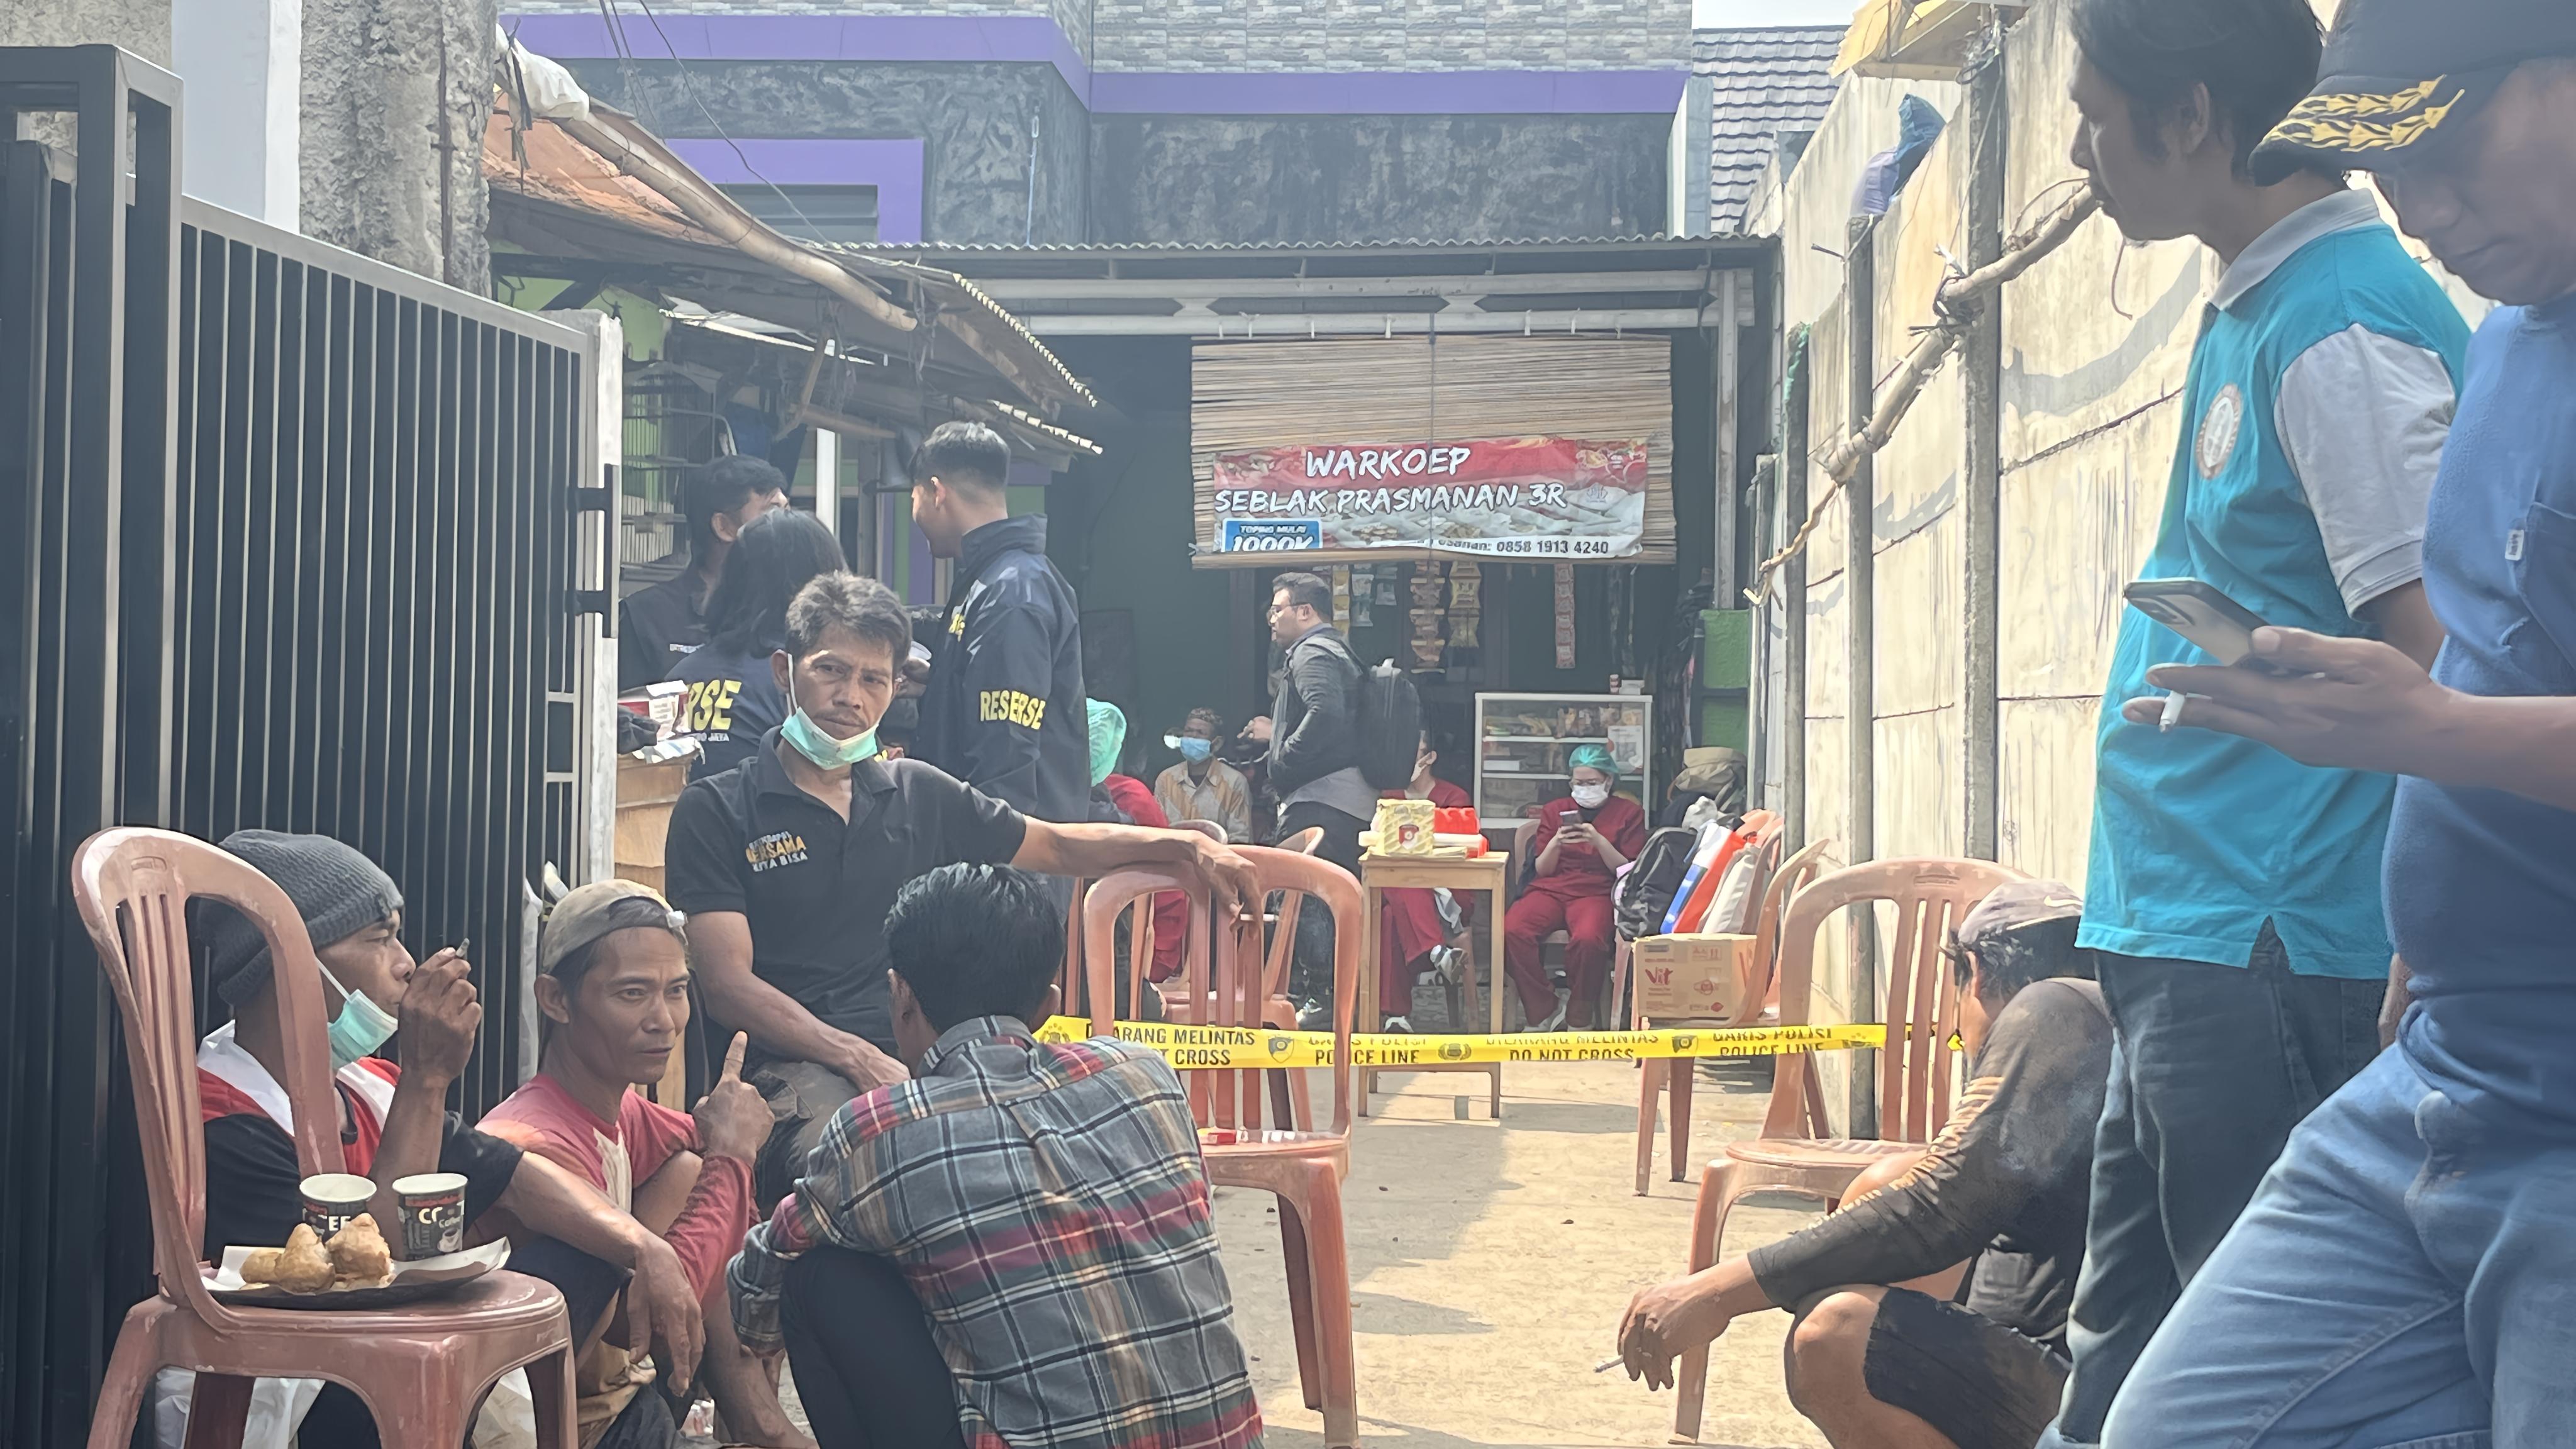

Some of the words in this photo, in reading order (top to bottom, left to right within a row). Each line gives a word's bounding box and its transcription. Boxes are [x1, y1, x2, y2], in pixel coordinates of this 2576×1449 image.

[1306, 448, 1470, 480] WARKOEP
[1214, 489, 1328, 516] SEBLAK
[1336, 484, 1519, 514] PRASMANAN
[1528, 484, 1567, 508] 3R
[1496, 541, 1531, 552] 0858
[1538, 541, 1568, 553] 1913
[1574, 541, 1609, 553] 4240
[980, 689, 1046, 730] RESERSE
[1174, 1028, 1255, 1045] MELINTAS
[1175, 1048, 1231, 1065] CROSS
[1382, 1049, 1420, 1064] LINE
